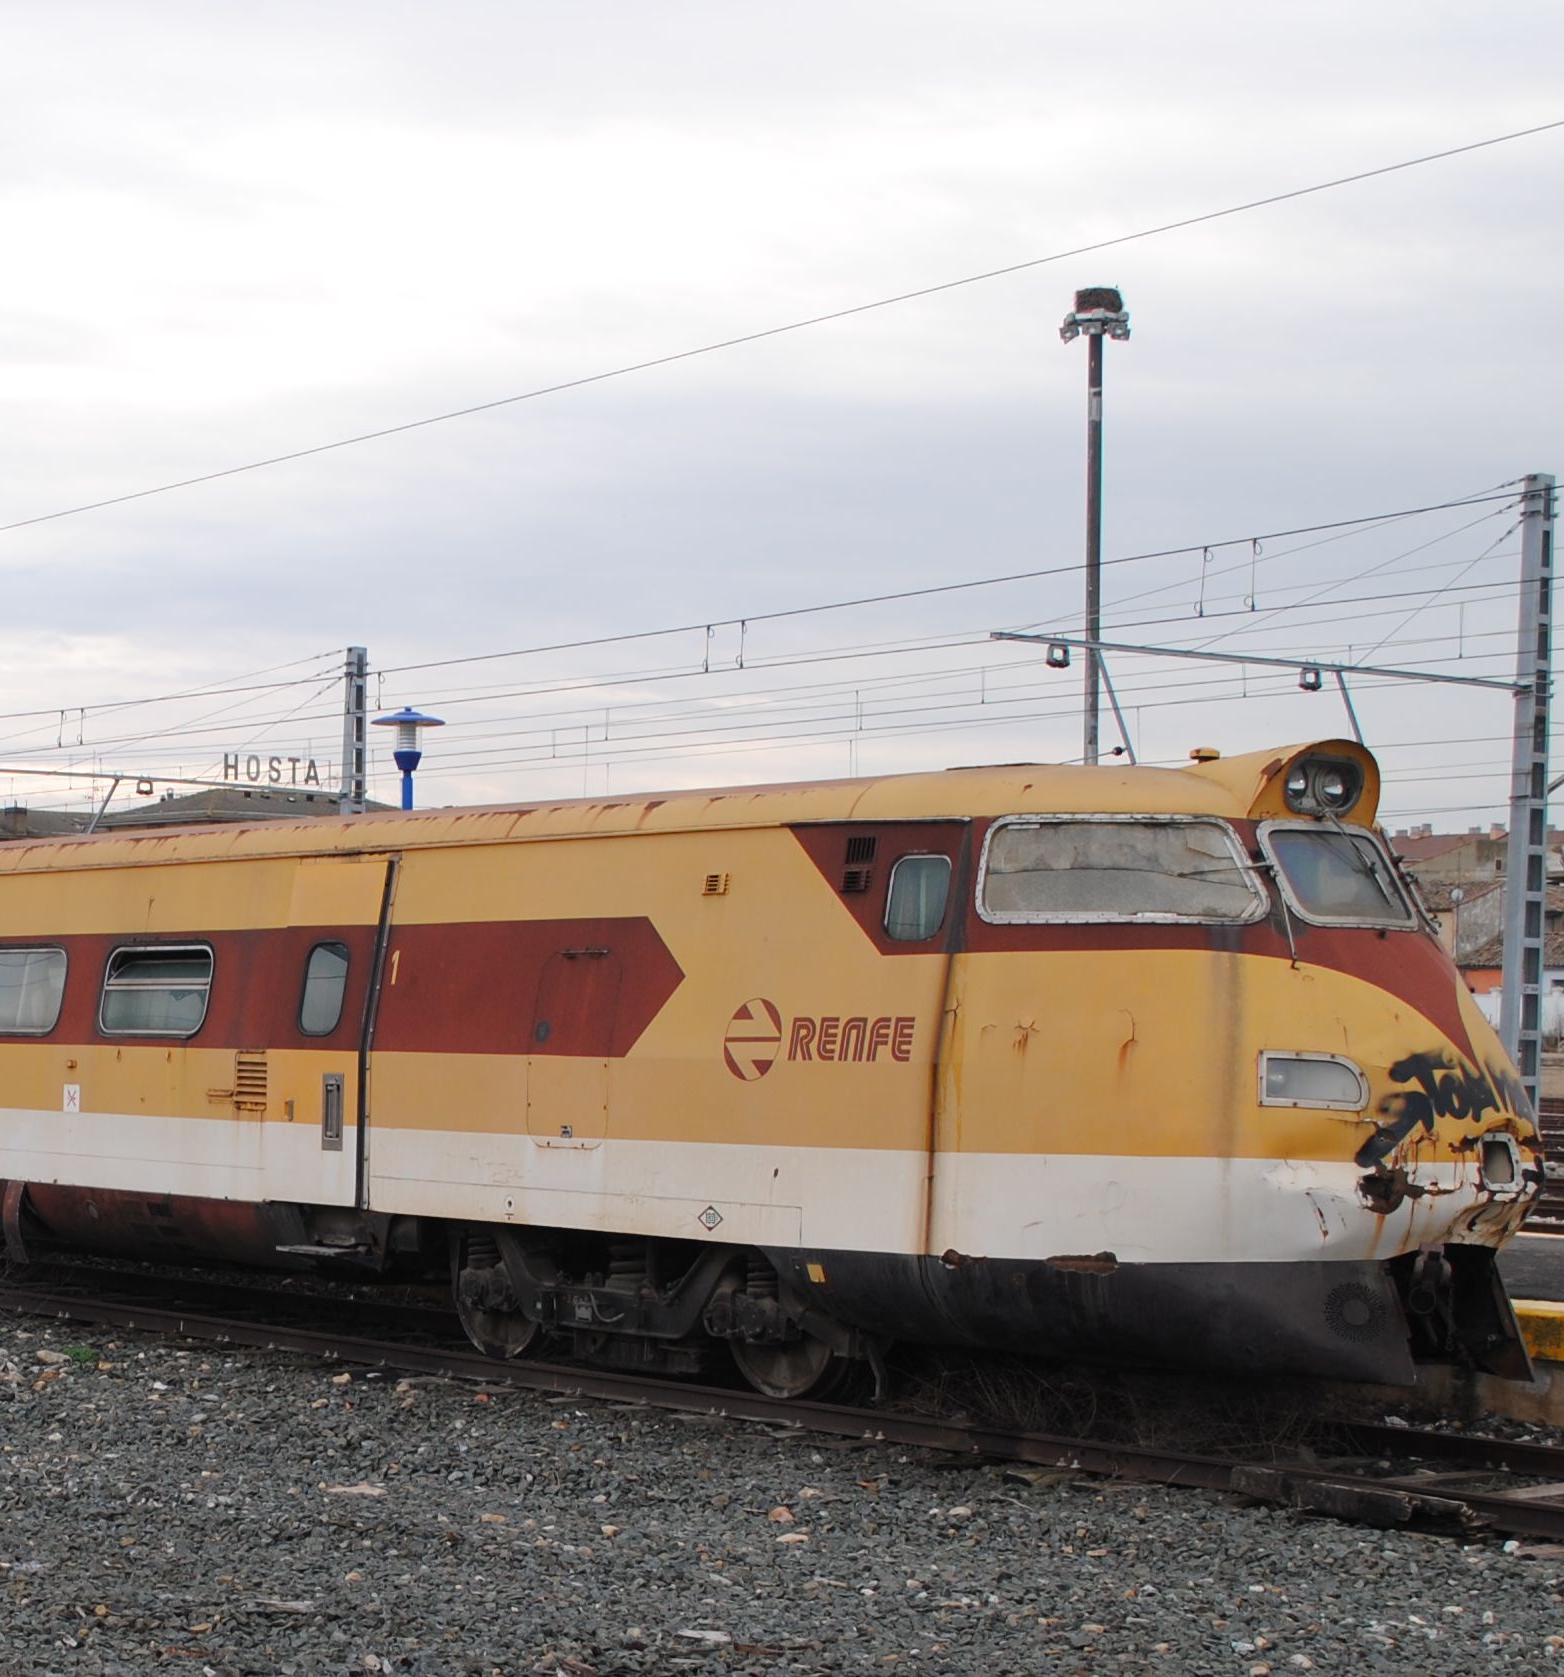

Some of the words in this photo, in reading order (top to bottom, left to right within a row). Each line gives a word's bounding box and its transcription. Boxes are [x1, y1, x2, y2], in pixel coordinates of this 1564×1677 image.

[223, 752, 320, 786] HOSTA
[390, 949, 401, 986] 1
[787, 1016, 916, 1063] RENFE
